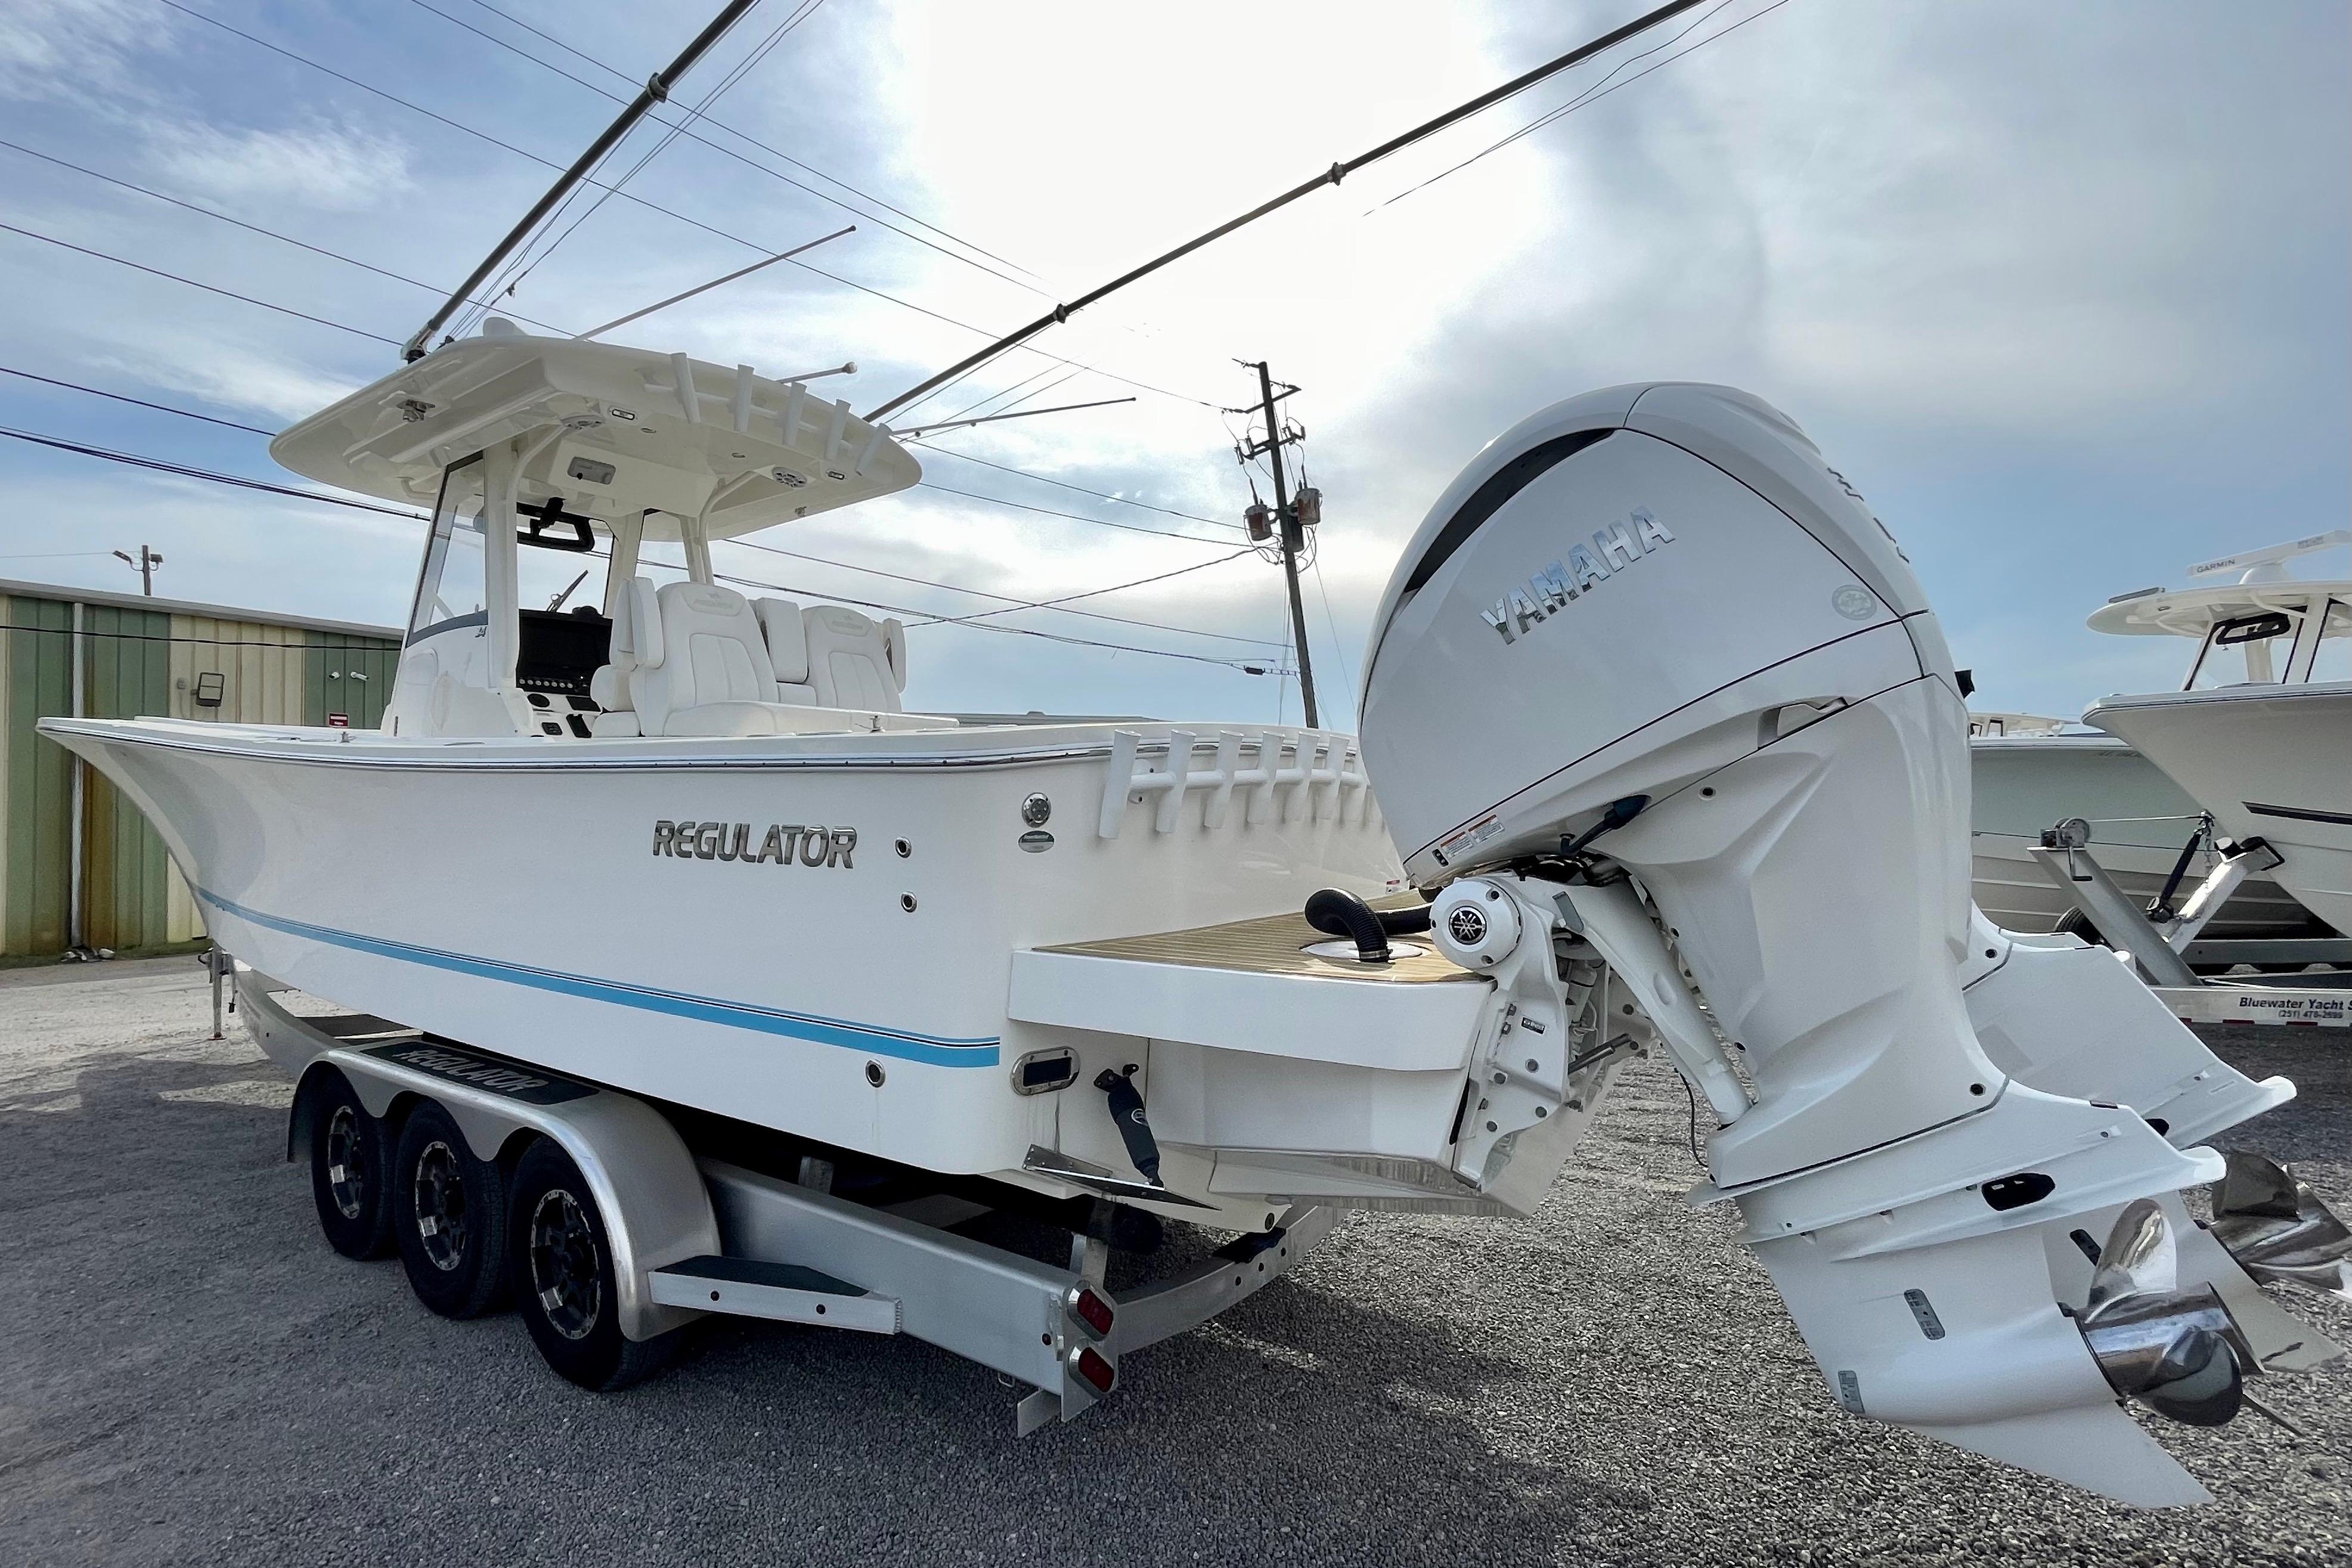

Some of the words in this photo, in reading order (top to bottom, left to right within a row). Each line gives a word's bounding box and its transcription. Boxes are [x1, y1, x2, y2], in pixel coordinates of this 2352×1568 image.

[1480, 505, 1676, 645] YAMAHA
[2196, 558, 2236, 574] GARMIN
[652, 820, 857, 869] REGULATOR
[2239, 997, 2304, 1009] Bluewater
[2308, 999, 2344, 1011] Yacht
[2279, 1010, 2300, 1018] (251)
[391, 1049, 549, 1092] REGULATOR
